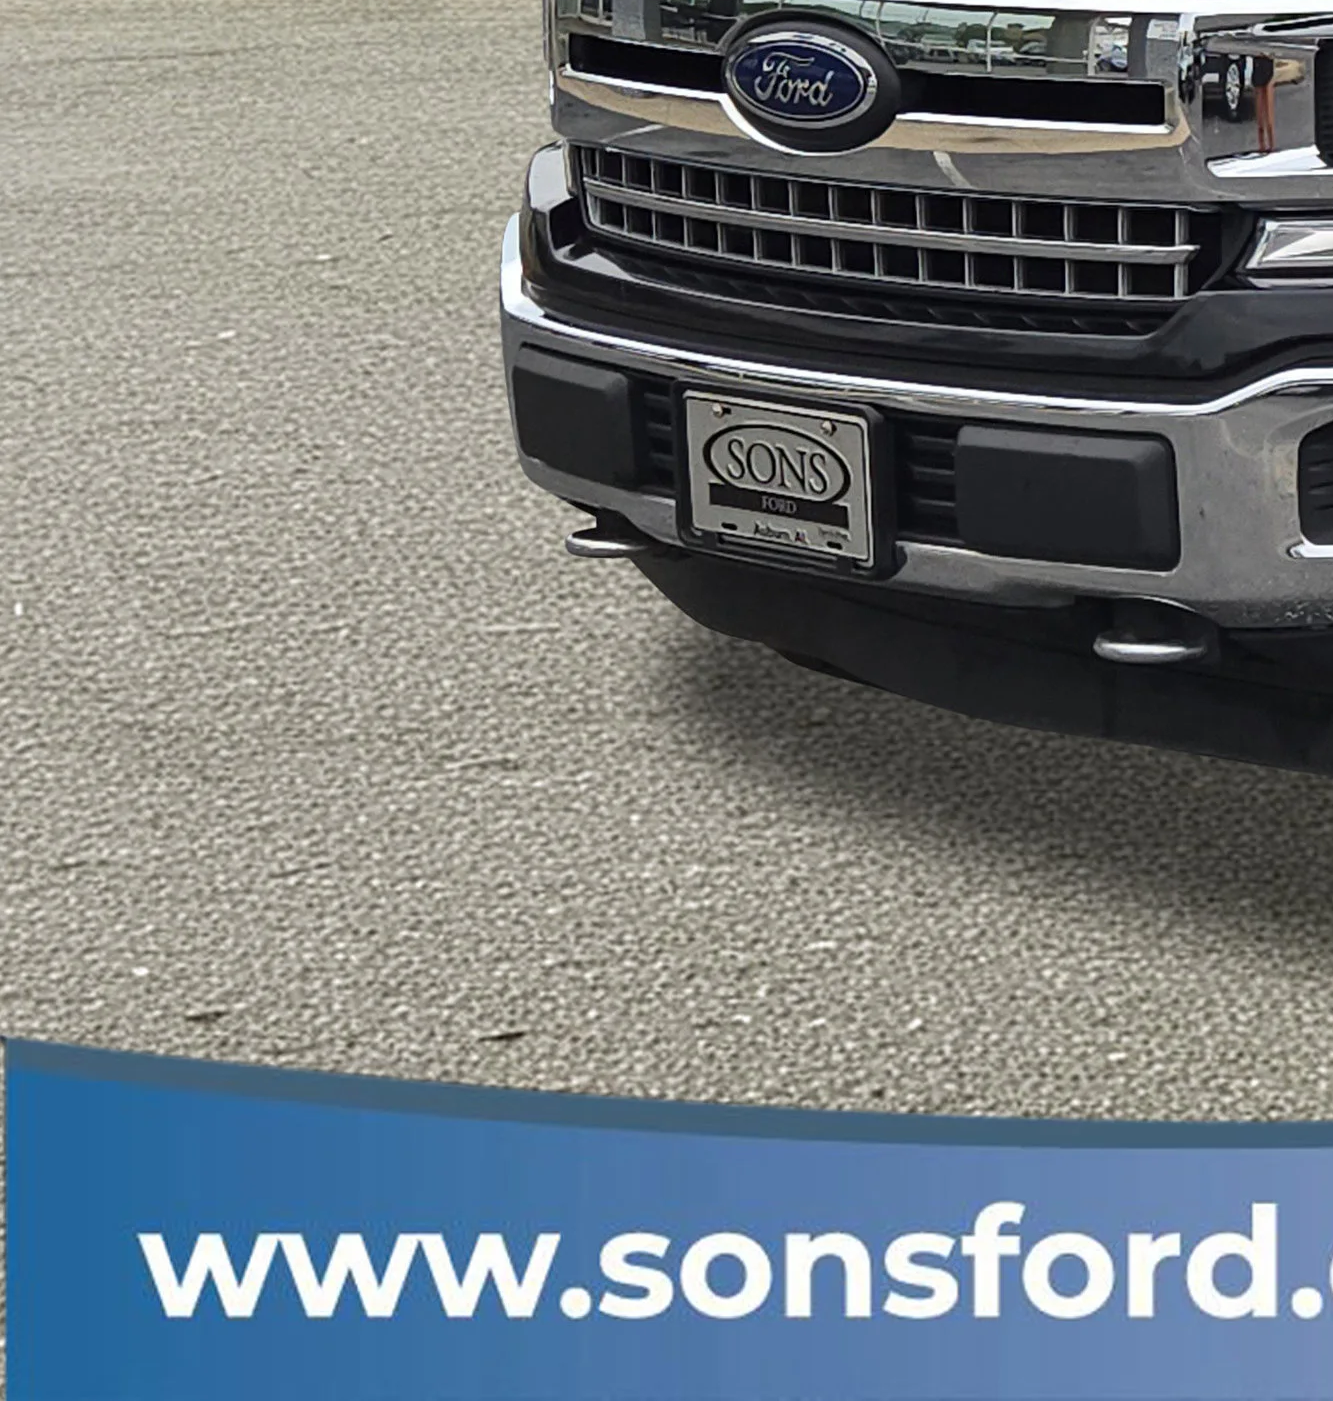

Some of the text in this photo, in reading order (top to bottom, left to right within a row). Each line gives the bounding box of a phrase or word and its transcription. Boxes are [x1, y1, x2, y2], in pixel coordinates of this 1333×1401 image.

[754, 52, 834, 107] Ford
[726, 437, 829, 495] SONS
[760, 495, 798, 515] FORD
